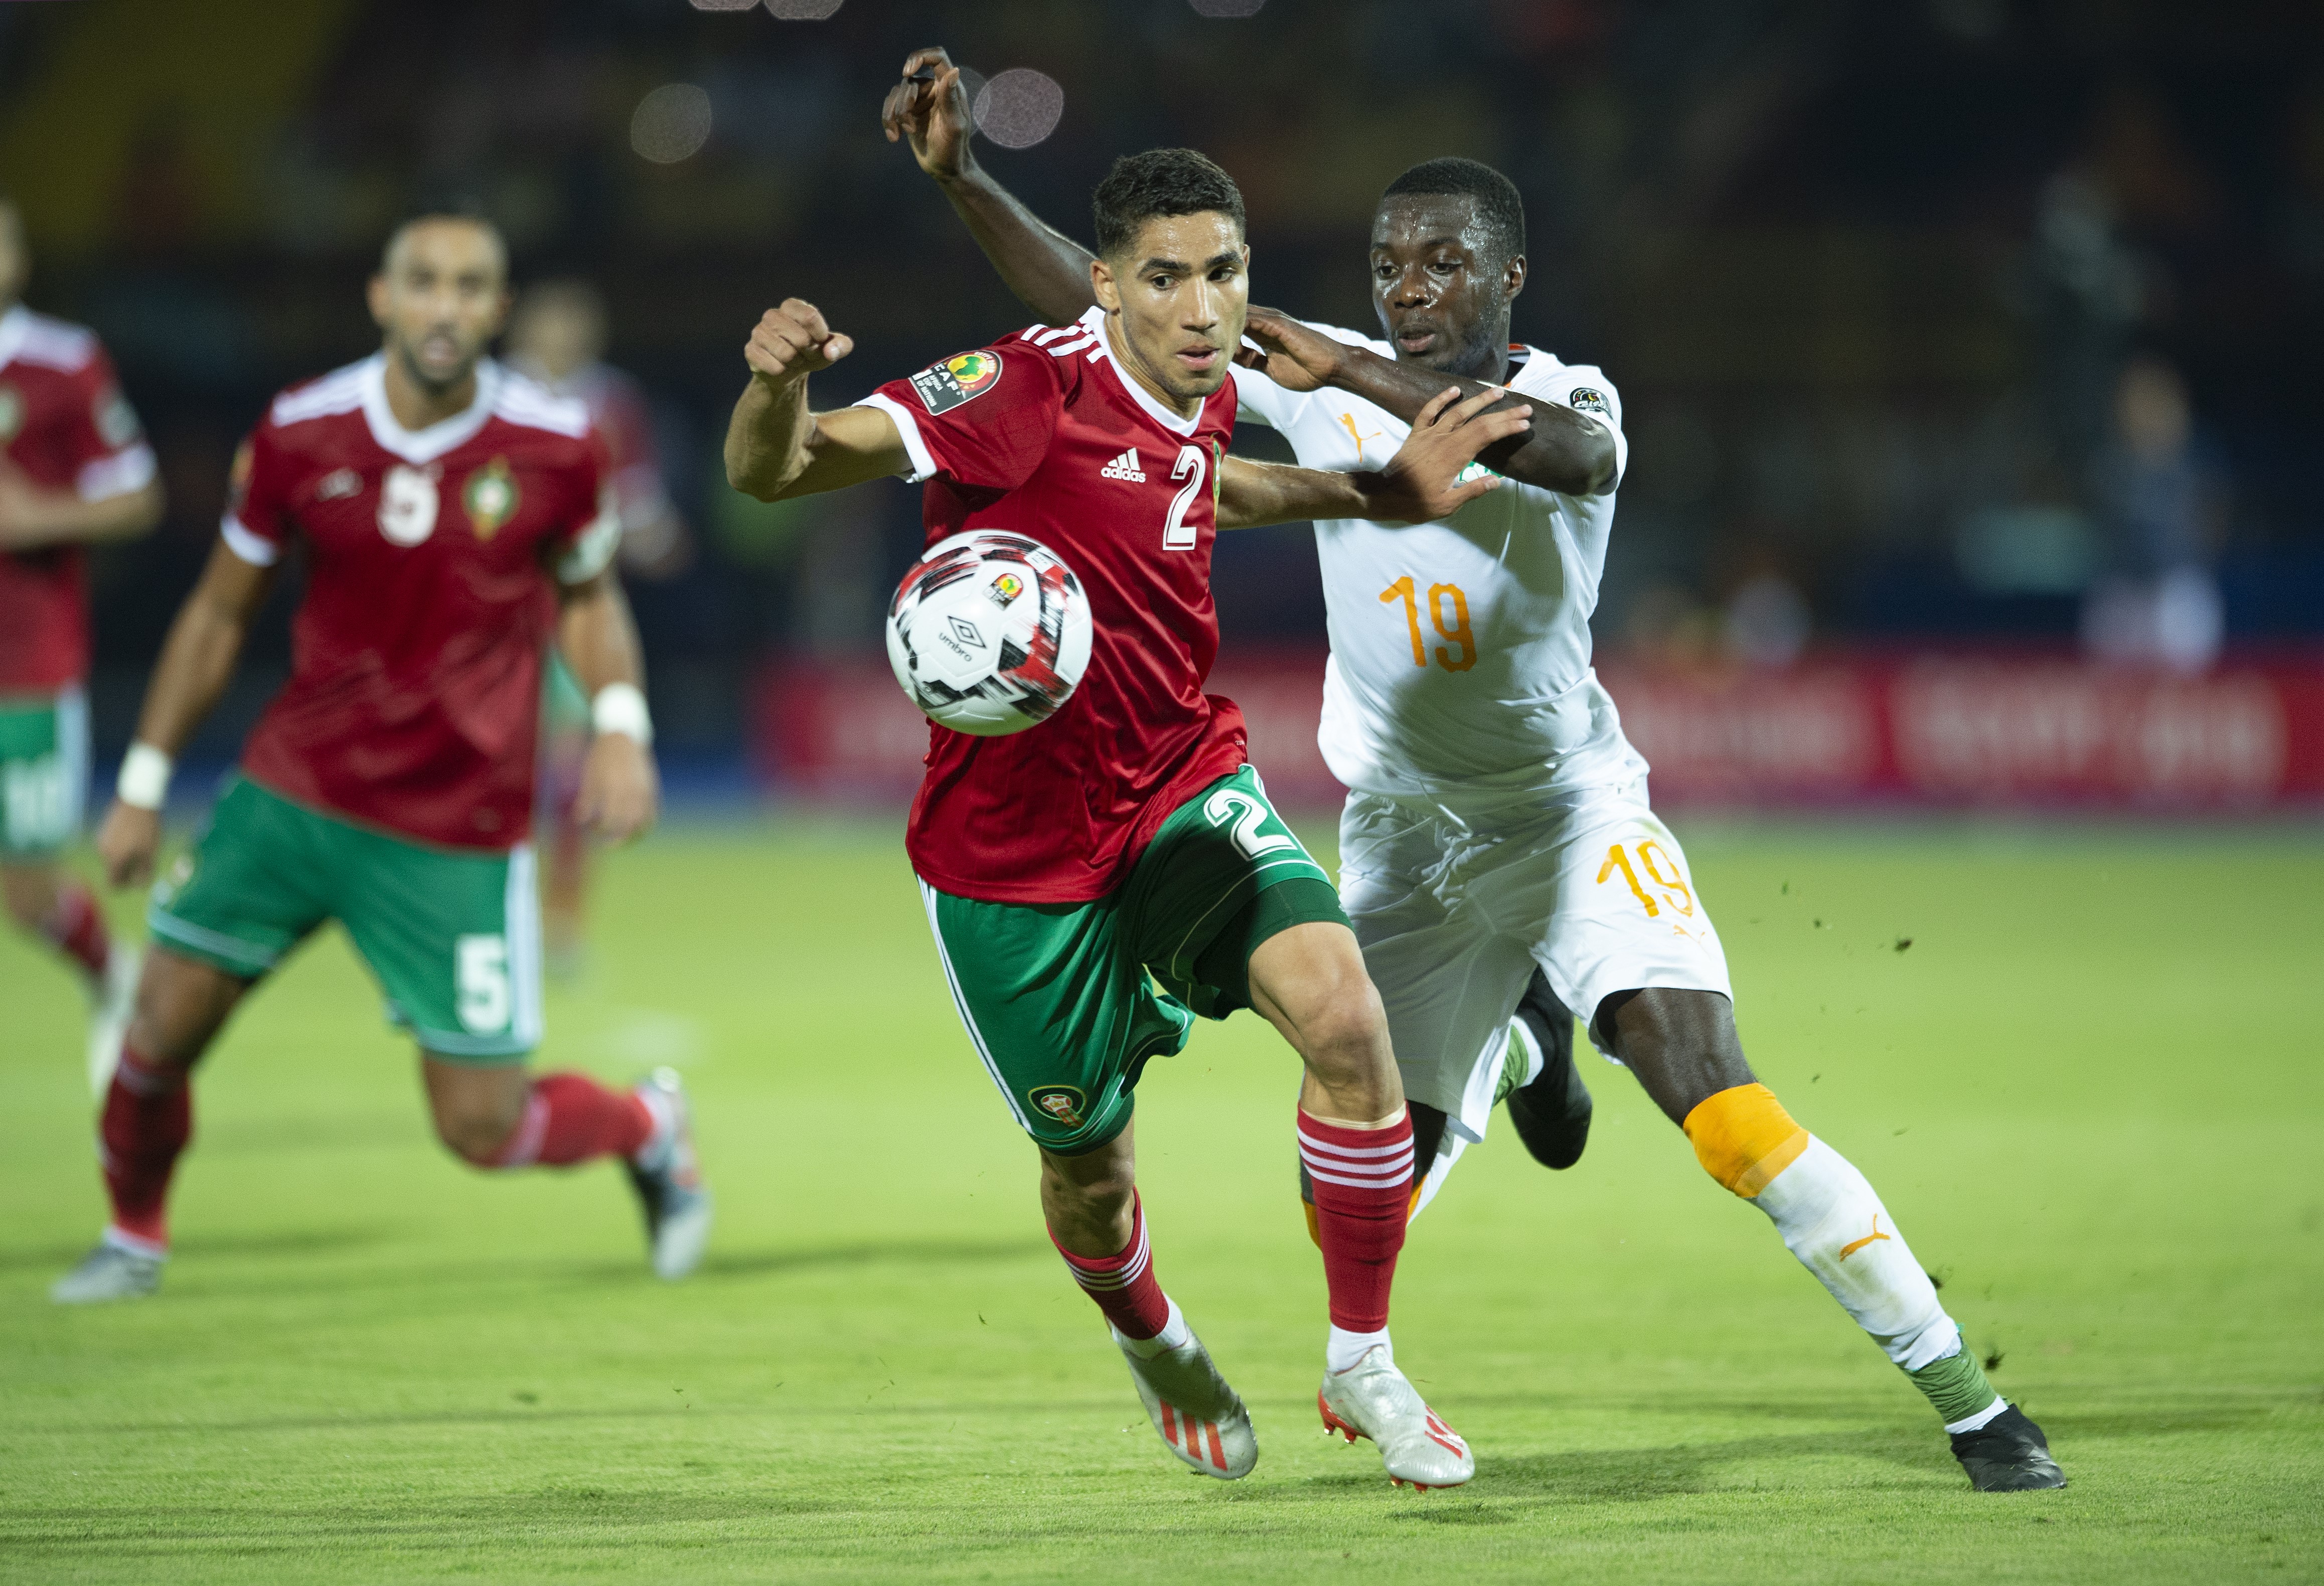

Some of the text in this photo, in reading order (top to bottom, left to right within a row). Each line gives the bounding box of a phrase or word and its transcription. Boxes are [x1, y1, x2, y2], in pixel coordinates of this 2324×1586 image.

[922, 378, 933, 387] CUP
[928, 375, 944, 392] AFRICA
[934, 364, 959, 391] CAF
[920, 387, 937, 407] NATIONS
[1101, 466, 1146, 483] adidas
[1162, 445, 1206, 551] 2
[1378, 576, 1477, 673] 19
[938, 632, 972, 662] umbro
[1203, 789, 1298, 862] 2
[1596, 838, 1693, 918] 19
[454, 933, 512, 1036] 5
